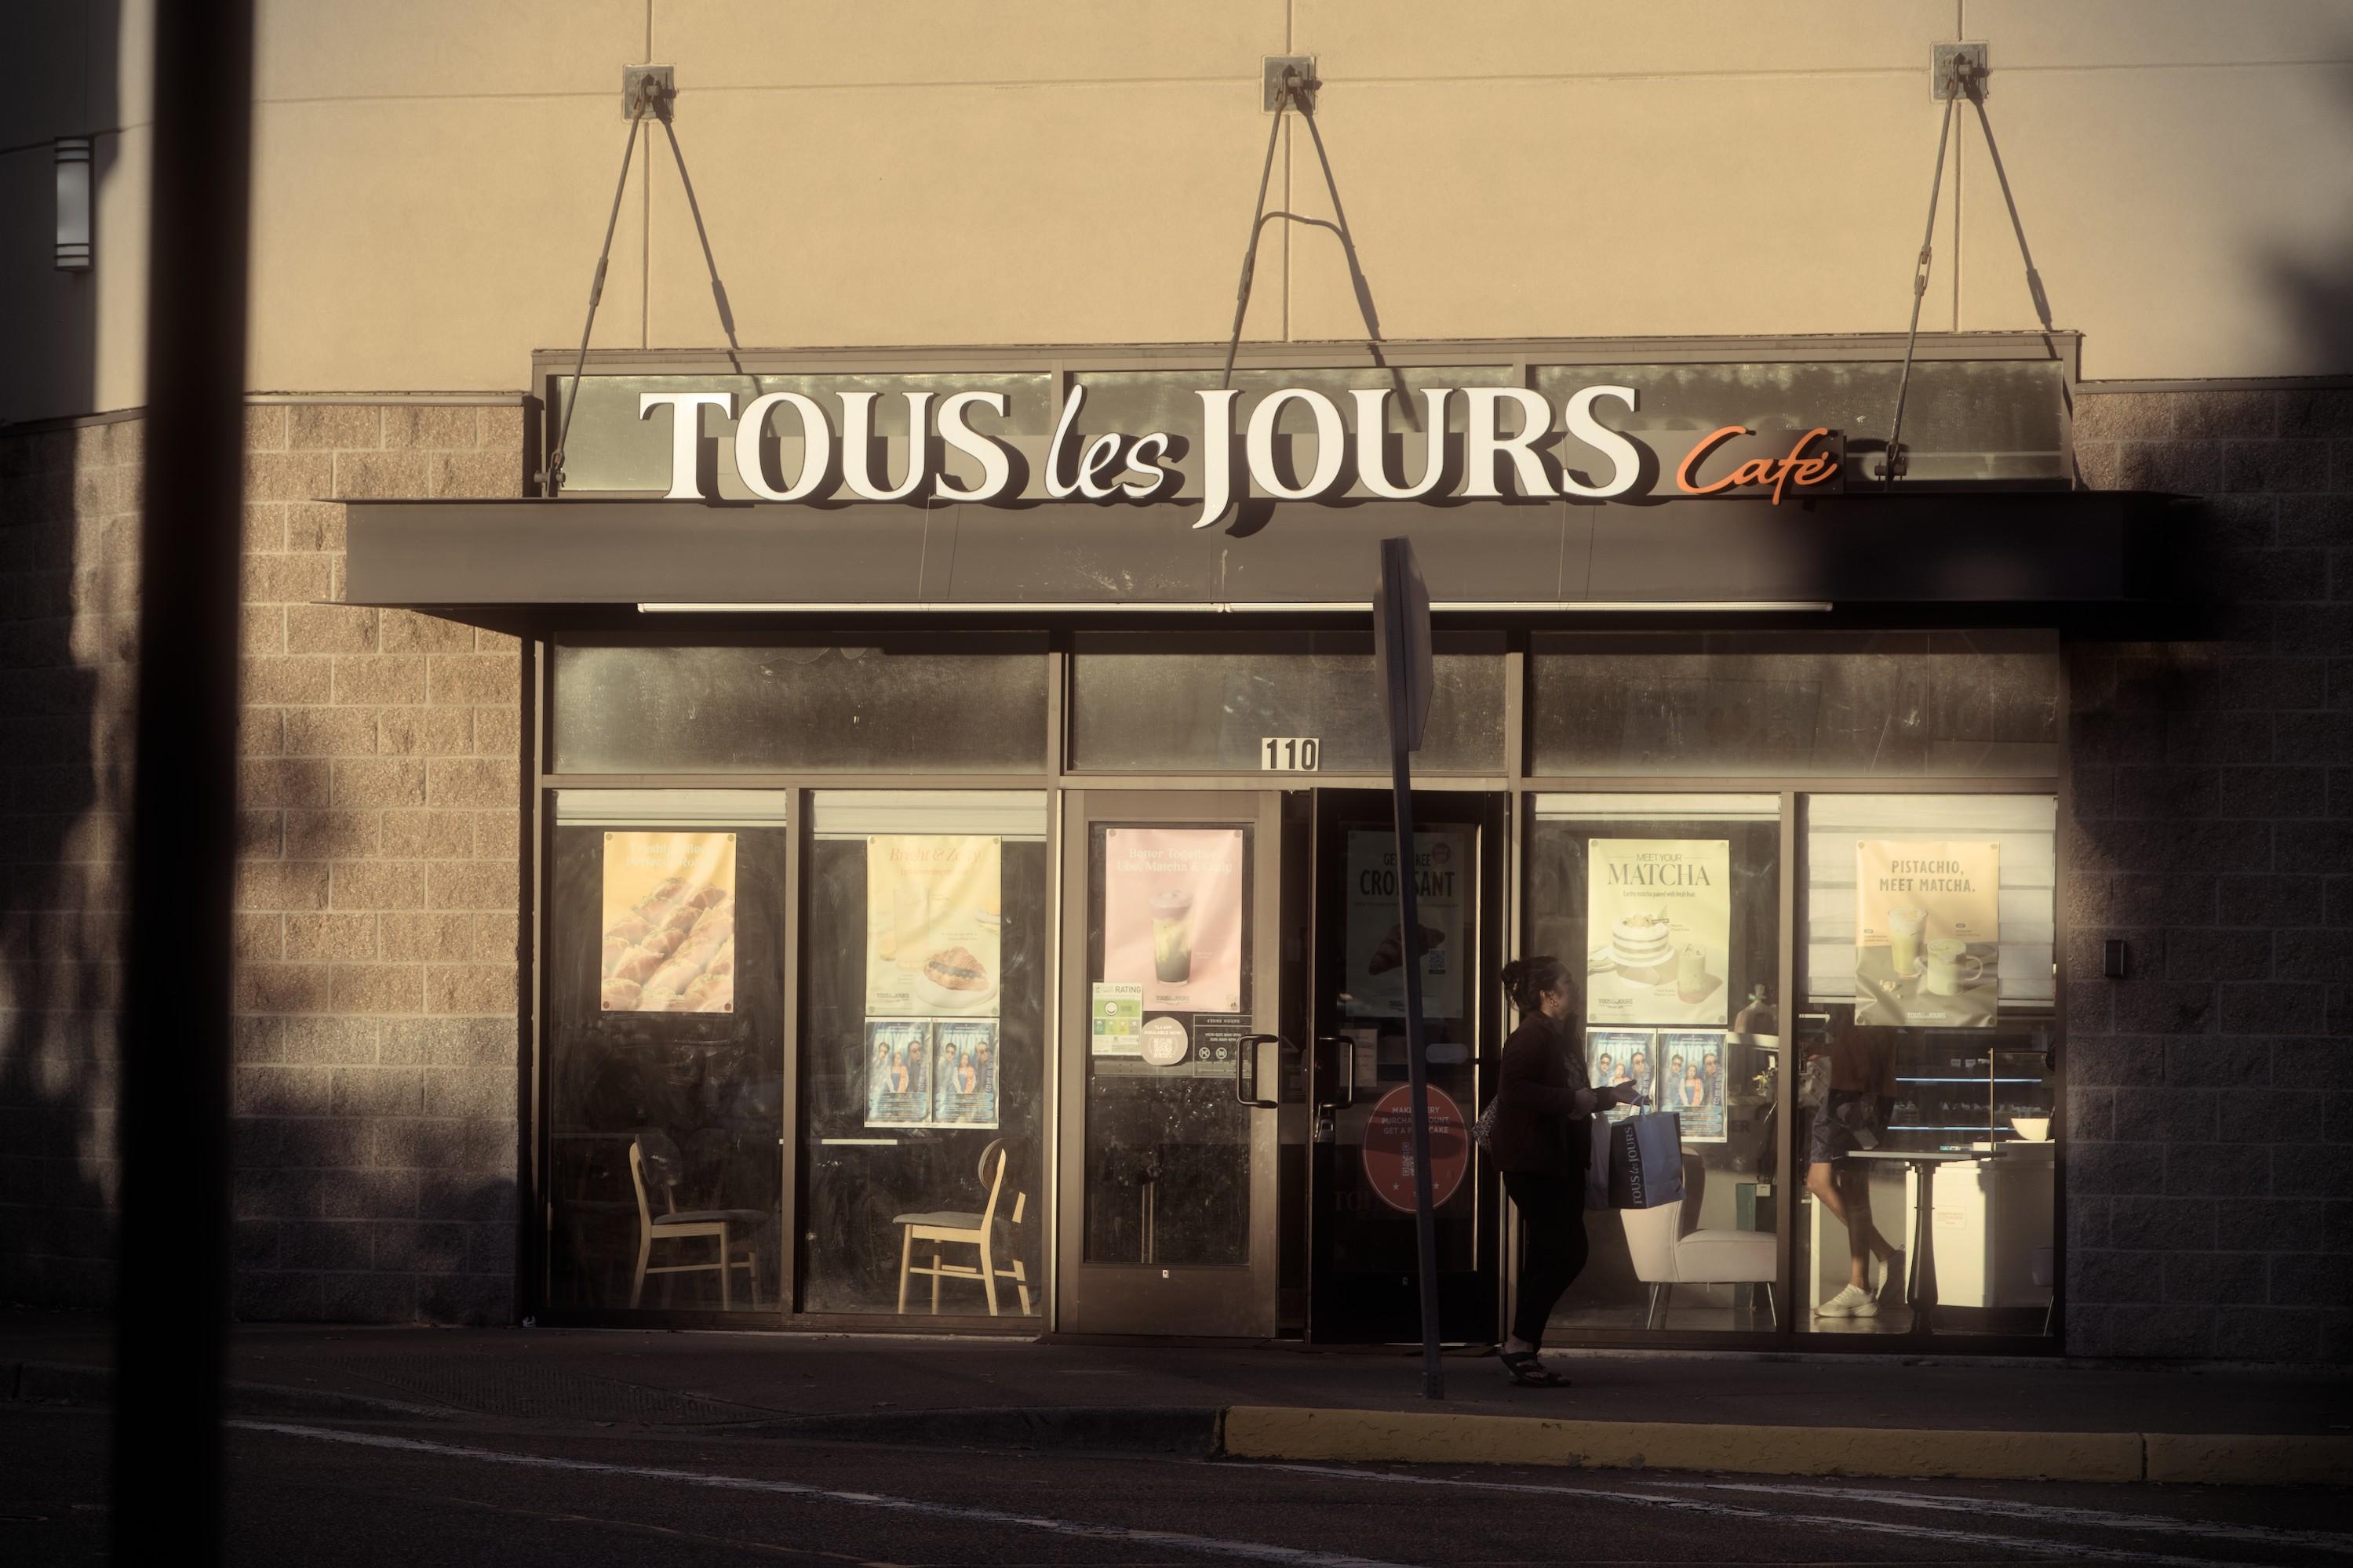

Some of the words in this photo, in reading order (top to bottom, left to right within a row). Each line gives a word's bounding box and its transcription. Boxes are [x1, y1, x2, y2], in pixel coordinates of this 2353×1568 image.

[639, 391, 1011, 501] TOUS
[1045, 384, 1168, 499] les
[1192, 384, 1641, 530] JOURS
[1676, 425, 1838, 506] Café
[1266, 739, 1317, 770] 110
[1659, 853, 1682, 862] YOUR
[1892, 860, 1964, 875] PISTACHIO,
[1608, 863, 1711, 886] MATCHA
[1879, 878, 1914, 892] MEET
[1919, 878, 1976, 892] MATCHA.
[1624, 1126, 1640, 1162] JOURS
[1630, 1175, 1643, 1205] TOUS
